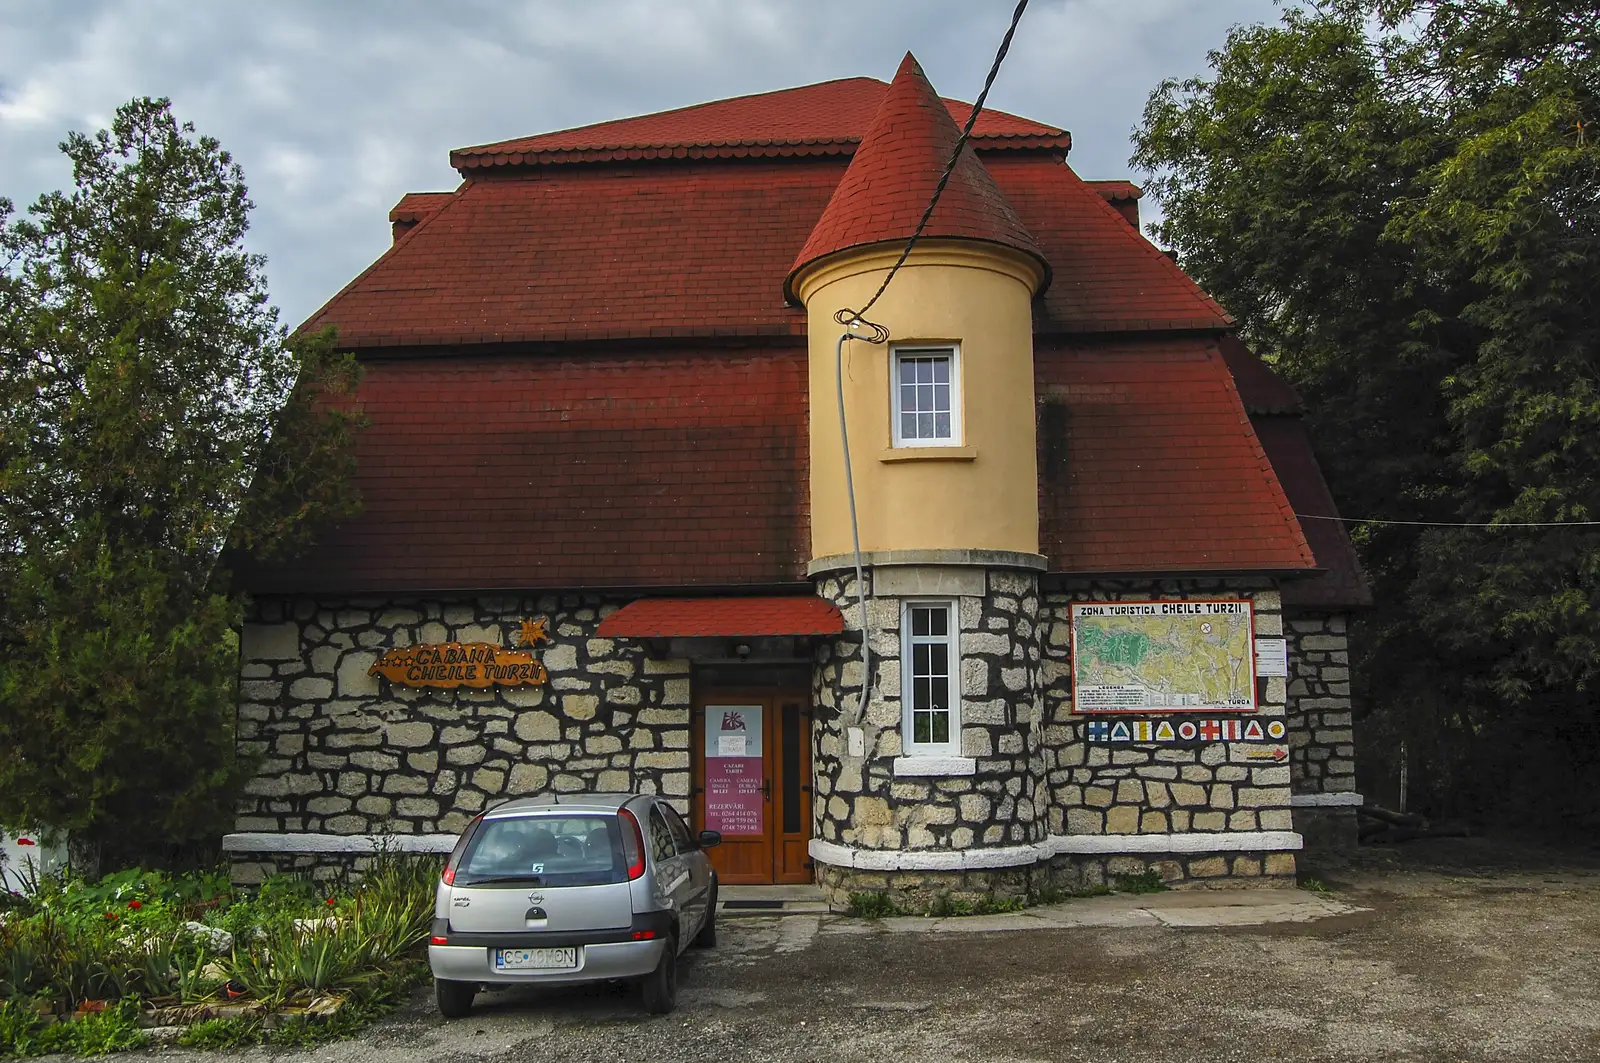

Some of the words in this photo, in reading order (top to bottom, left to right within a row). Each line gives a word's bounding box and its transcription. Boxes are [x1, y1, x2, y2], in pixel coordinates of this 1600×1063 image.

[1081, 607, 1104, 615] ZONA
[1109, 605, 1156, 615] TURISTICA
[1162, 603, 1202, 614] CHEILE
[1206, 603, 1242, 614] TURZII
[416, 648, 496, 665] CABANA
[407, 665, 477, 681] CHEILE
[484, 664, 542, 680] TURZII
